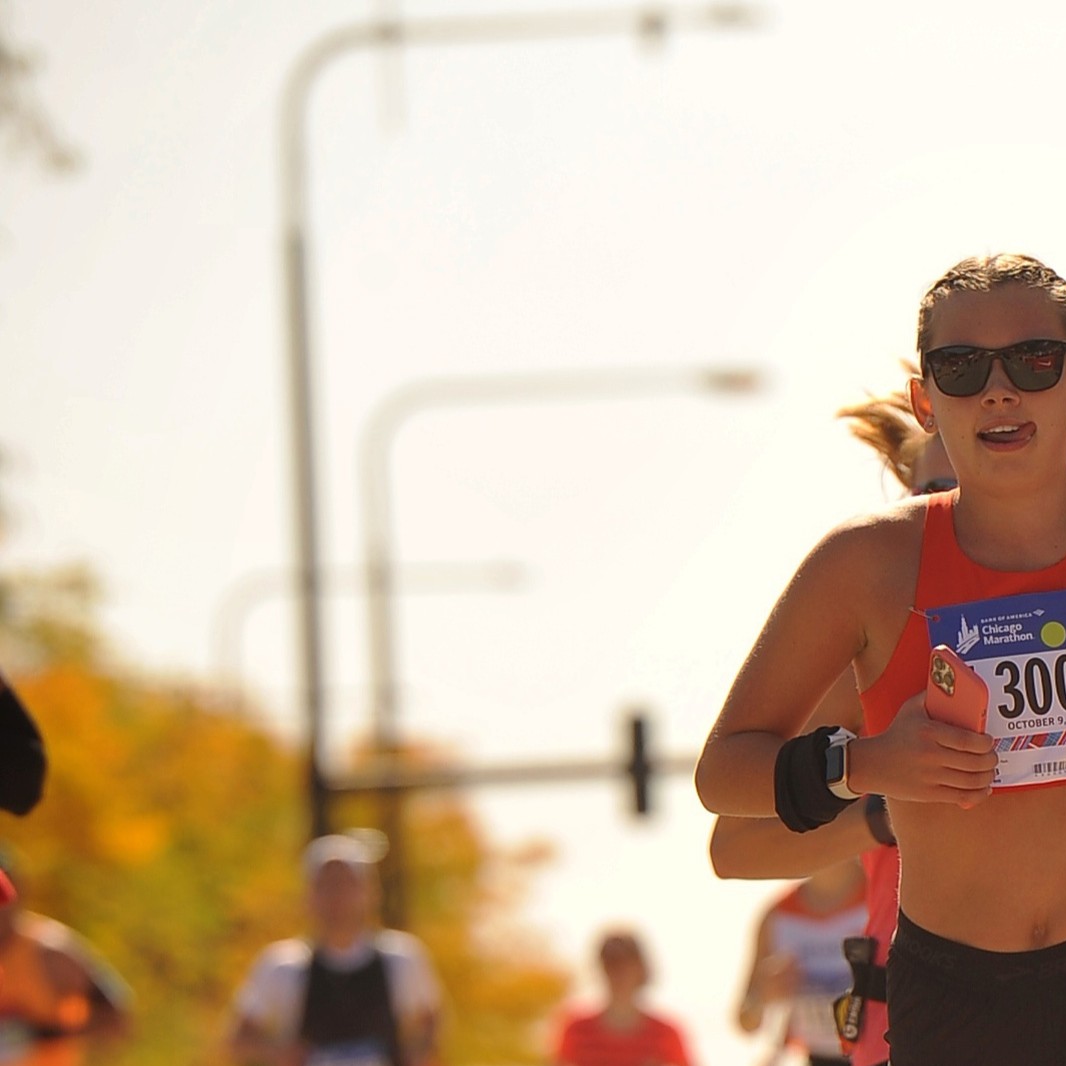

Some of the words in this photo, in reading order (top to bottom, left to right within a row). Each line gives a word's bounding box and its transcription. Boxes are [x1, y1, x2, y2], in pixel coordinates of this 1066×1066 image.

[1006, 612, 1033, 620] AMERICA
[982, 623, 1023, 635] Chicago
[983, 629, 1033, 646] Marathon
[1007, 717, 1055, 731] OCTOBER
[1057, 716, 1066, 727] 9,
